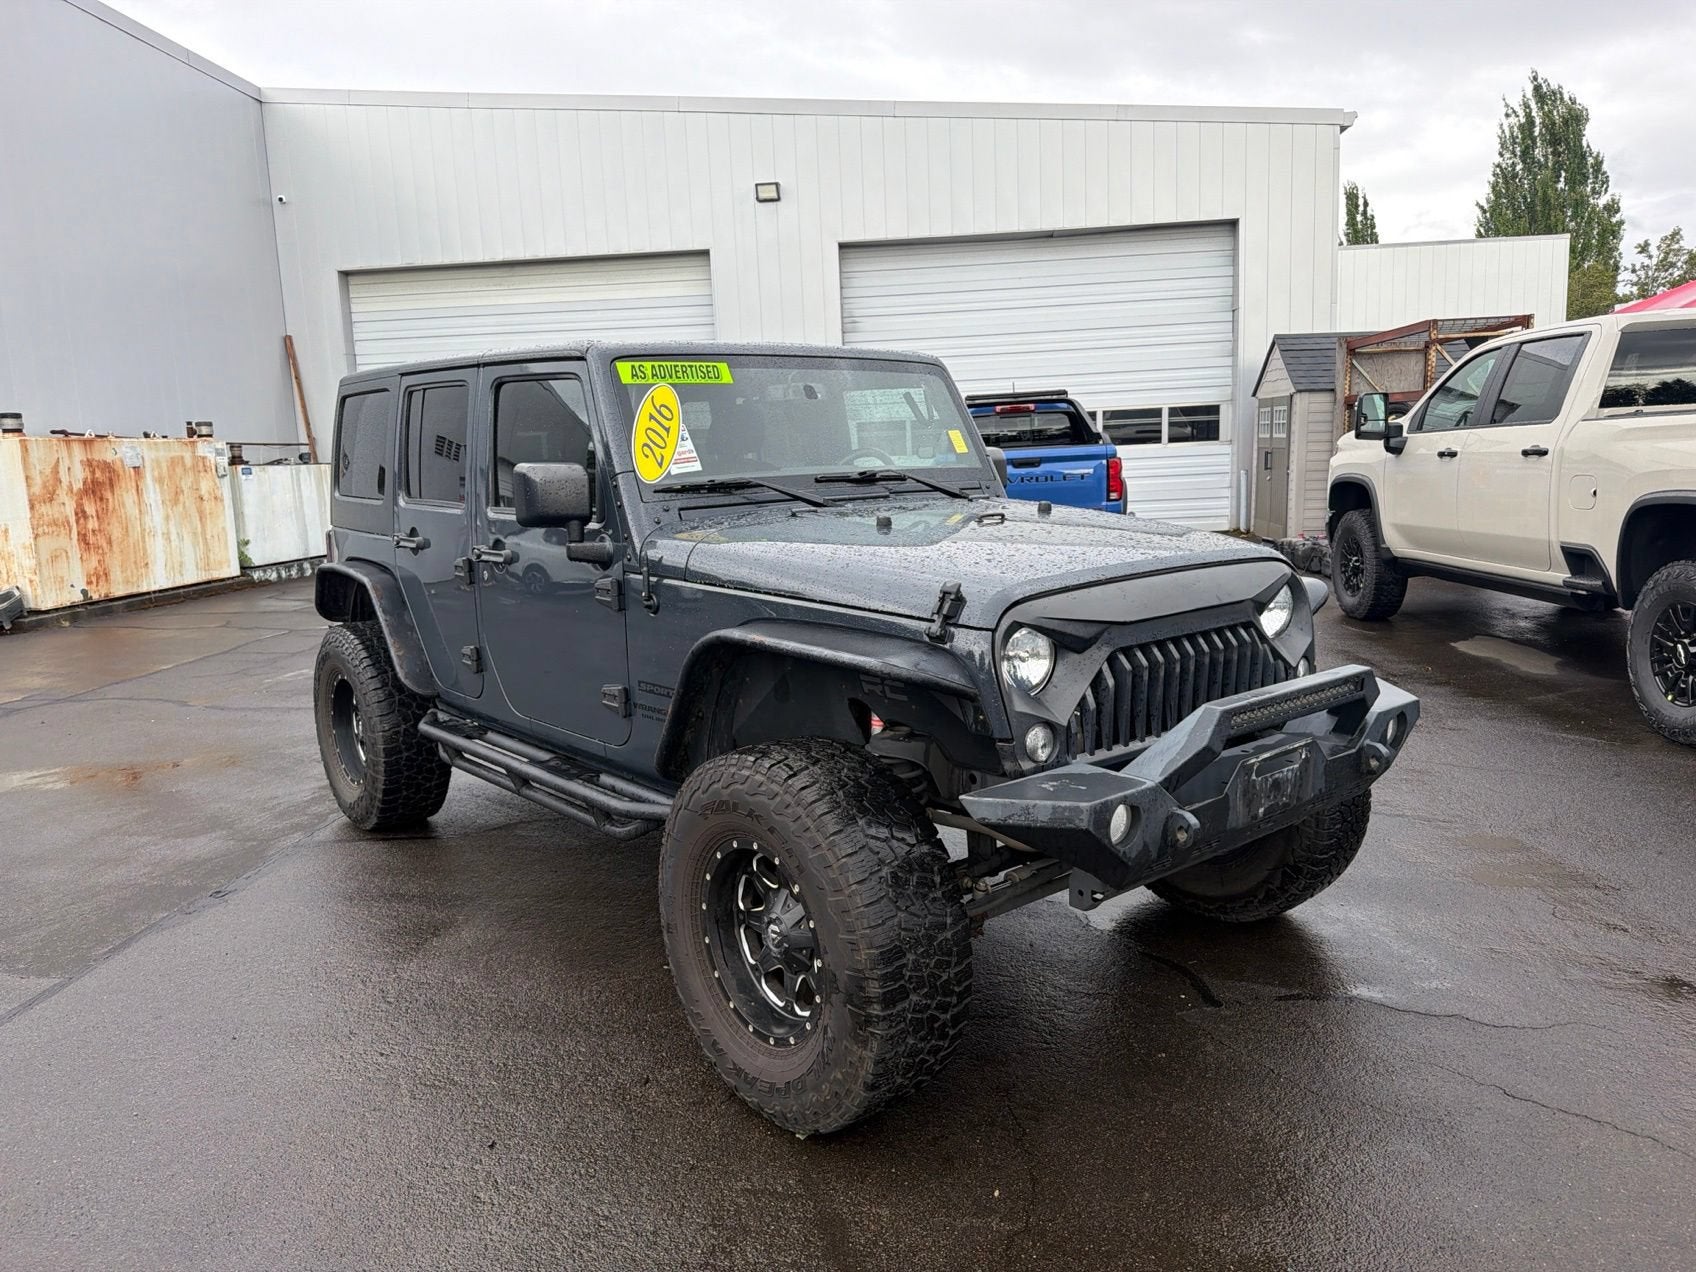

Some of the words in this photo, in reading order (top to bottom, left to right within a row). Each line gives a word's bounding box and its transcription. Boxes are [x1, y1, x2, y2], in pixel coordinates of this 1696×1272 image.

[631, 364, 647, 380] AS
[651, 364, 720, 380] ADVERTISED
[641, 395, 674, 469] 2016
[1007, 473, 1088, 484] VROLET
[640, 682, 675, 696] SPORT
